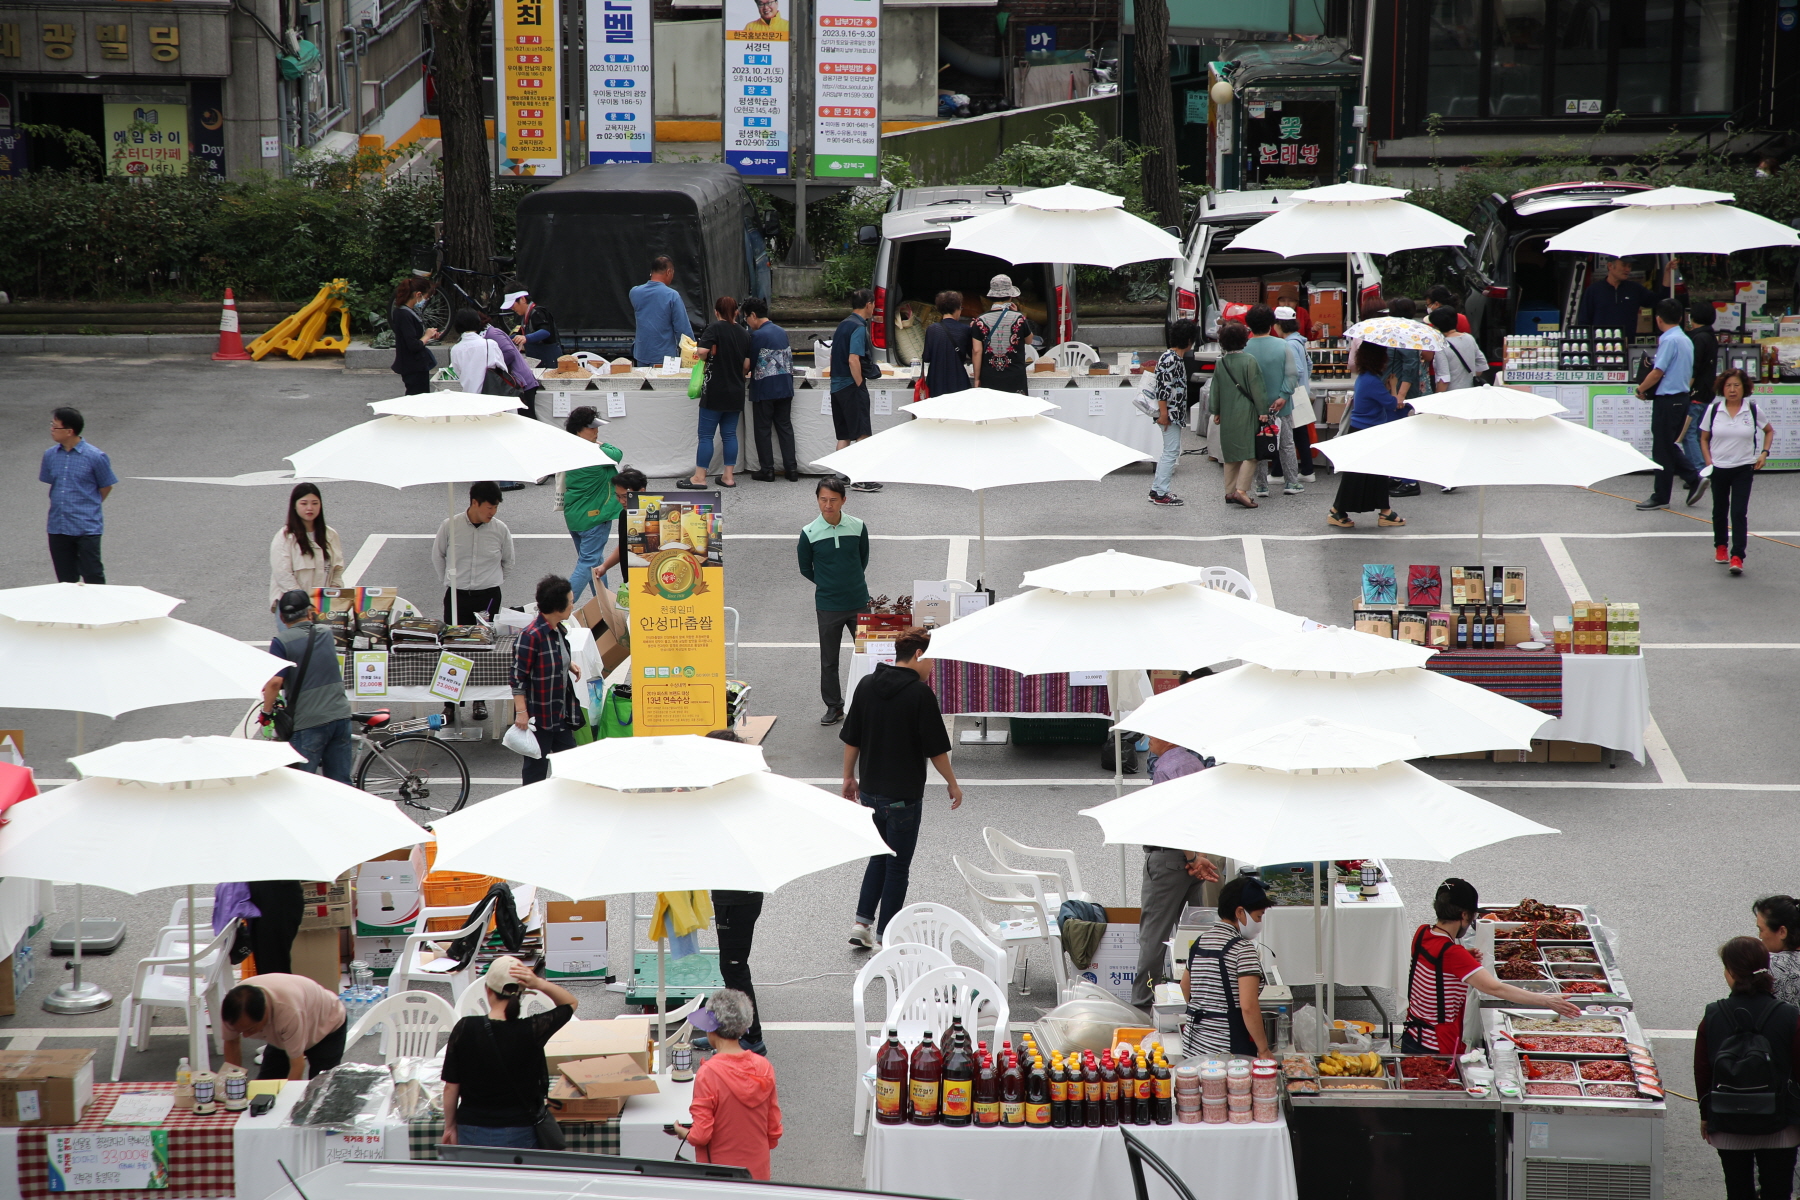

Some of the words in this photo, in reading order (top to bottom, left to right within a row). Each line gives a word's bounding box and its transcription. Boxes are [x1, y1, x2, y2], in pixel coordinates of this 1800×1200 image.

[516, 0, 542, 26] 최
[834, 18, 863, 26] 납부기간
[733, 31, 783, 40] 한국홍보전문가
[822, 30, 876, 38] 2023.9.16~9.30
[745, 43, 770, 52] 서경덕
[834, 64, 863, 73] 납부방법
[744, 75, 783, 83] 14:00~15:30
[592, 89, 612, 98] 우이동
[612, 90, 633, 98] 만남의
[633, 90, 647, 98] 광장
[738, 97, 777, 106] 평생학습관
[1278, 116, 1302, 140] 꽃
[603, 132, 646, 140] 02-901-2351
[738, 129, 777, 138] 평생학습관
[742, 138, 780, 147] 02-901-2351
[112, 147, 181, 160] 스터디카페
[201, 143, 224, 157] Day
[1258, 142, 1320, 165] 노래방
[1586, 371, 1605, 381] 제품
[1607, 371, 1627, 381] 판매
[660, 605, 695, 615] 천혜일미
[640, 615, 713, 632] 안성마춤쌀
[646, 697, 661, 705] 13년
[663, 696, 690, 705] 연속수상
[1109, 971, 1138, 985] 청피
[343, 1135, 364, 1143] 직거래
[366, 1135, 380, 1143] 장터
